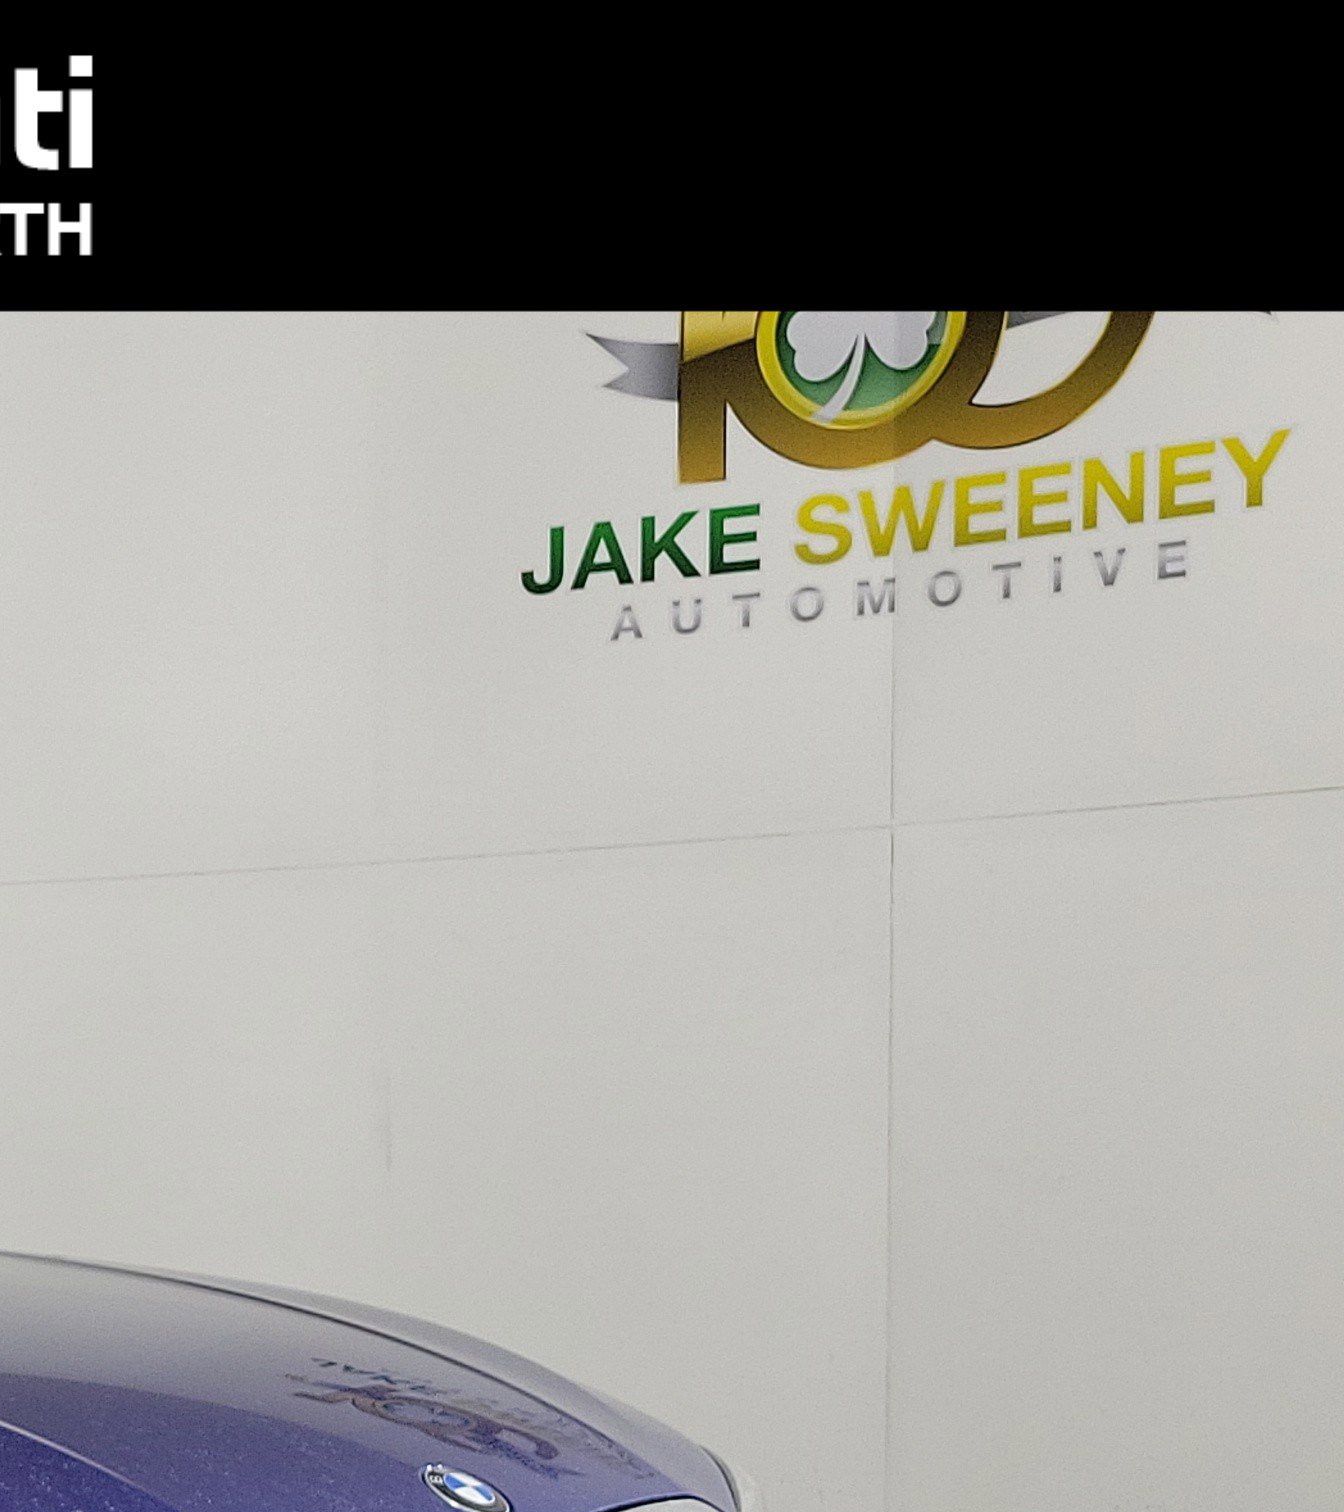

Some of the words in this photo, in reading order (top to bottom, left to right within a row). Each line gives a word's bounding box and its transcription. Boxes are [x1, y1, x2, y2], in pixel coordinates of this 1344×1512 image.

[520, 503, 761, 595] JAKE
[794, 427, 1292, 566] SWEENEY
[610, 540, 1189, 642] AUTOMOTIVE
